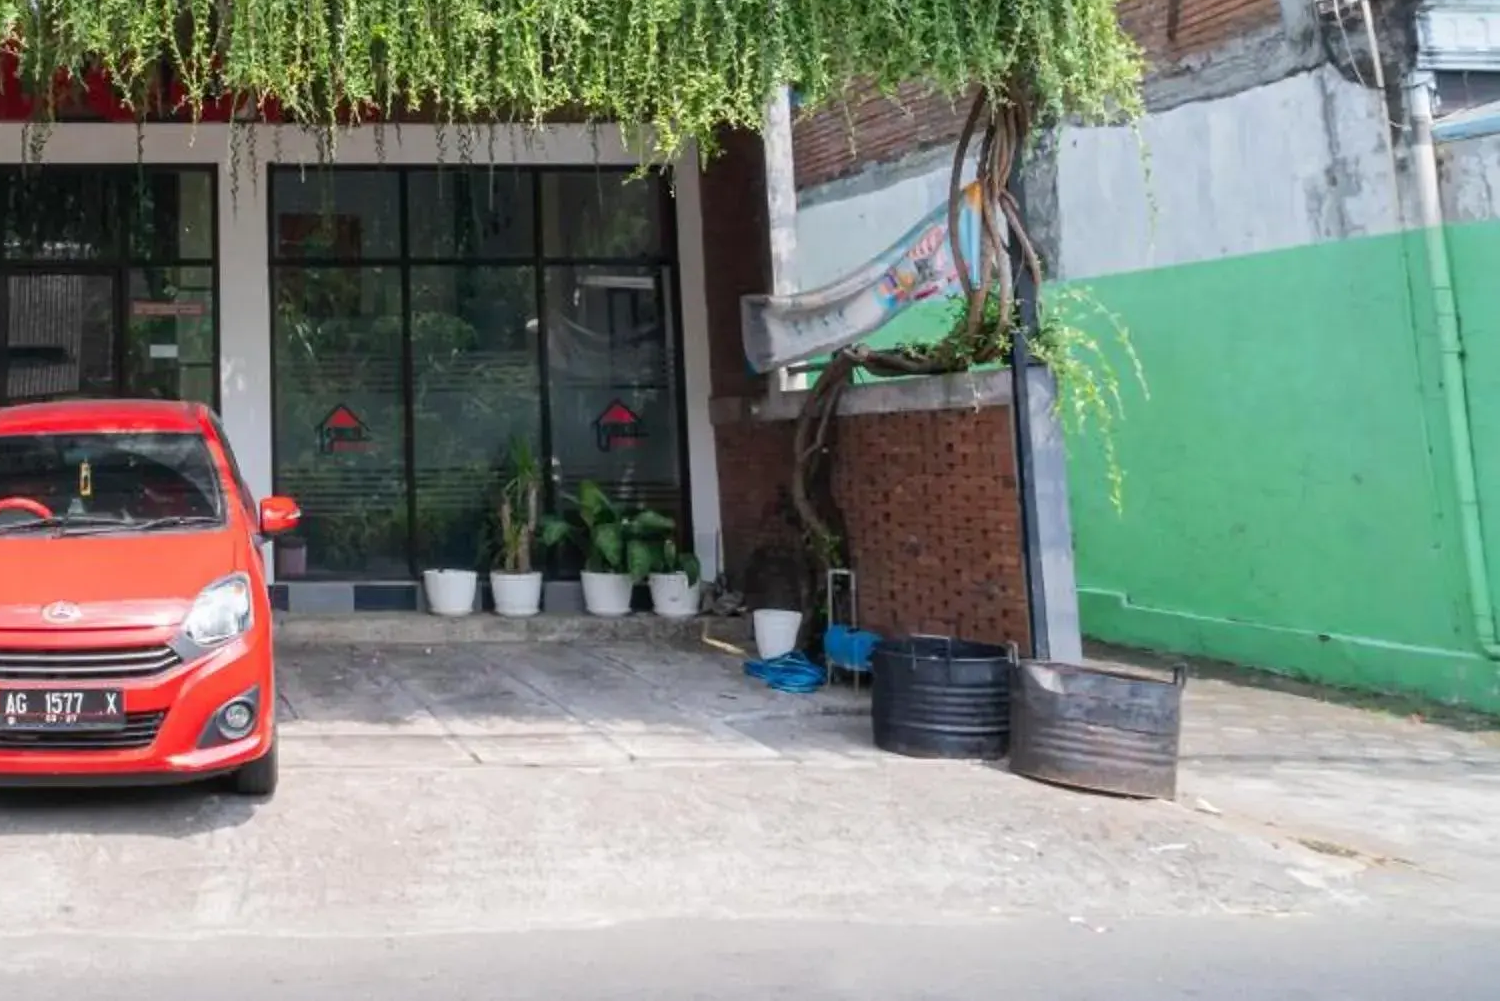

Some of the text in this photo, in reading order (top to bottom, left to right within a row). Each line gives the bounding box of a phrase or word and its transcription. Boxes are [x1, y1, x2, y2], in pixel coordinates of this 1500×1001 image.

[5, 692, 117, 715] AG 1577 X
